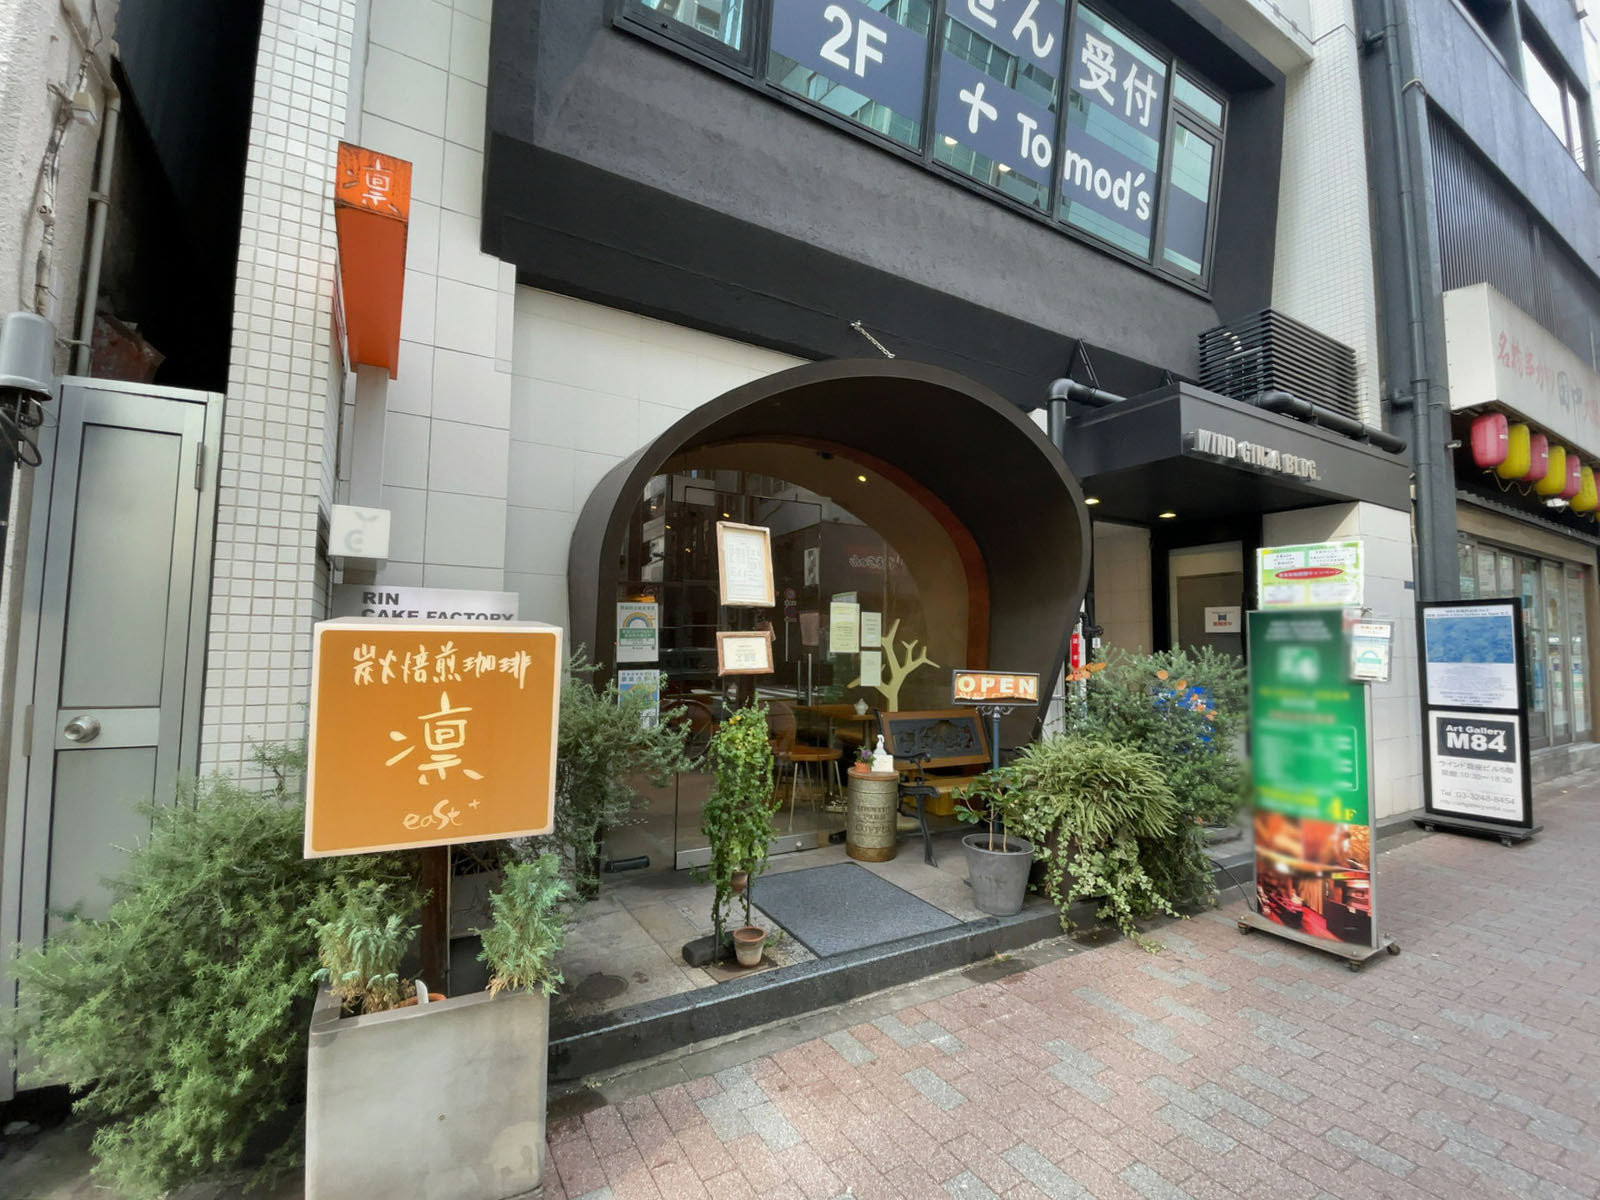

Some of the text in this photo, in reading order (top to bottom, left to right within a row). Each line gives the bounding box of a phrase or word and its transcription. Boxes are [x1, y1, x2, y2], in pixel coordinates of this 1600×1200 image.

[819, 4, 888, 78] 2F
[1196, 428, 1237, 458] WIND
[1238, 440, 1281, 471] GINZA
[362, 591, 400, 605] RIN
[353, 641, 533, 689] 炭火焙煎珈琲
[958, 676, 1035, 694] OPEN
[1445, 724, 1506, 737] Art Gallery
[1446, 732, 1507, 753] M84
